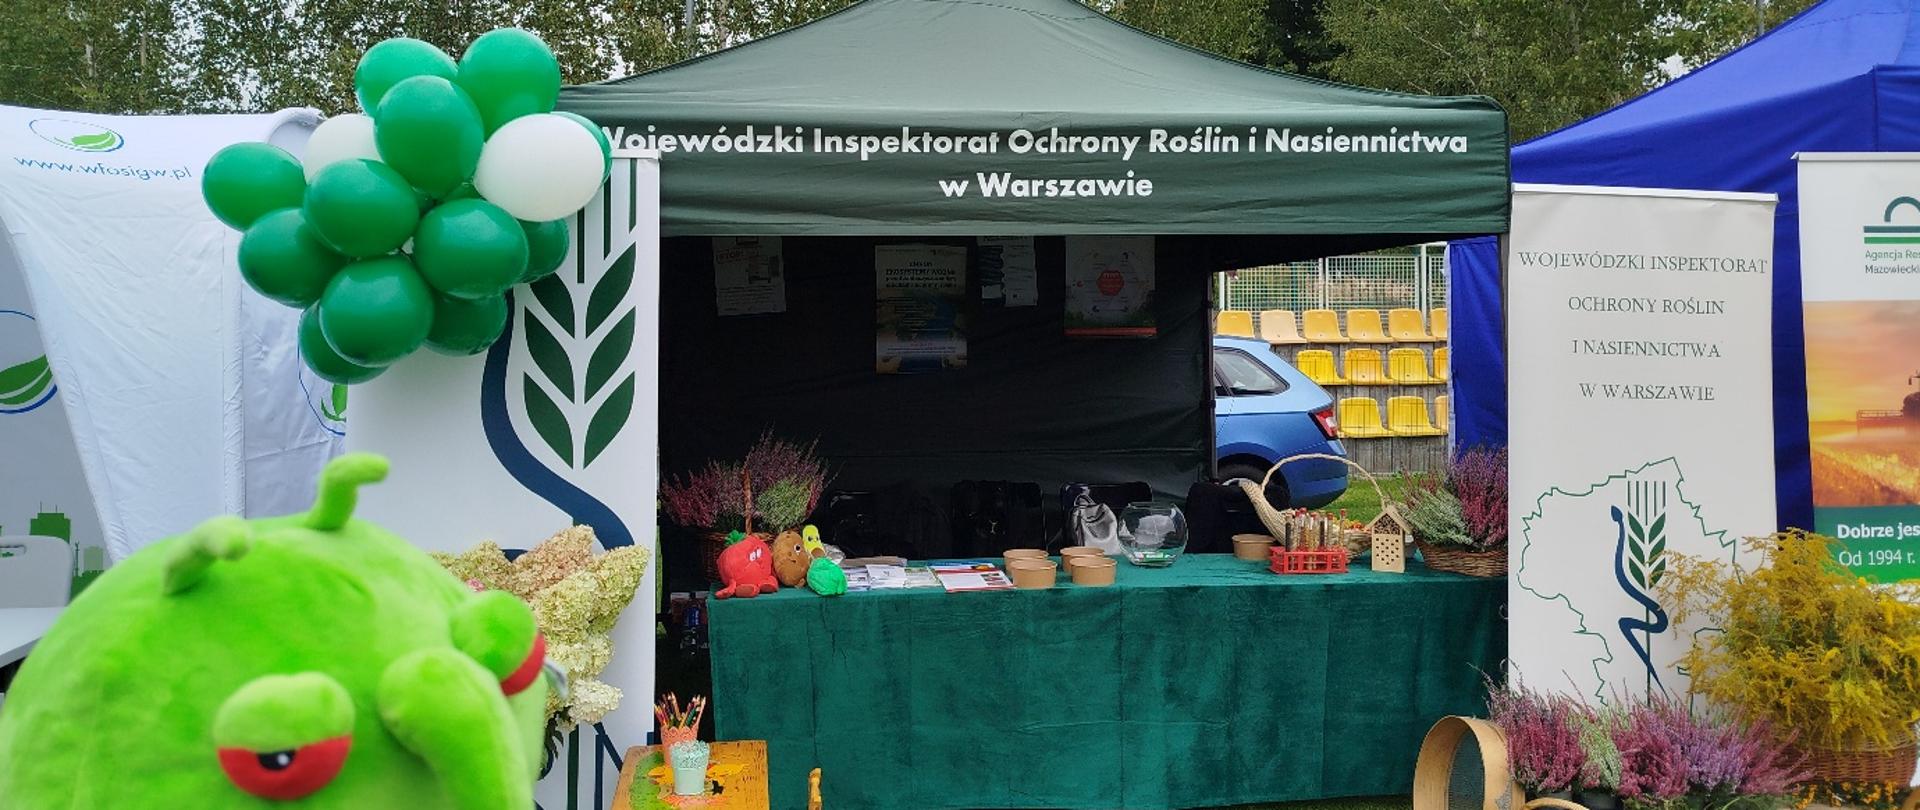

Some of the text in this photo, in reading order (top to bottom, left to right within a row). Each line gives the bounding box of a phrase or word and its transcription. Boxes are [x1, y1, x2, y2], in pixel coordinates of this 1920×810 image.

[813, 126, 1000, 161] Inspektorat
[1008, 127, 1142, 161] Ochrony
[1148, 126, 1240, 153] Roślin
[1248, 126, 1257, 153] i
[1265, 126, 1469, 154] Nasiennictwa
[938, 169, 1153, 198] w Warszawie
[1518, 250, 1768, 274] WOJEWÓDZKI INSPEKTORAT
[1865, 250, 1903, 261] Agencja
[1568, 296, 1725, 315] OCHRONY ROŚLIN
[1573, 338, 1722, 358] I NASIENNICTWA
[1579, 382, 1715, 401] W WARSZAWIE
[1837, 523, 1894, 539] Dobrze
[1838, 549, 1916, 567] Od 1994 r.
